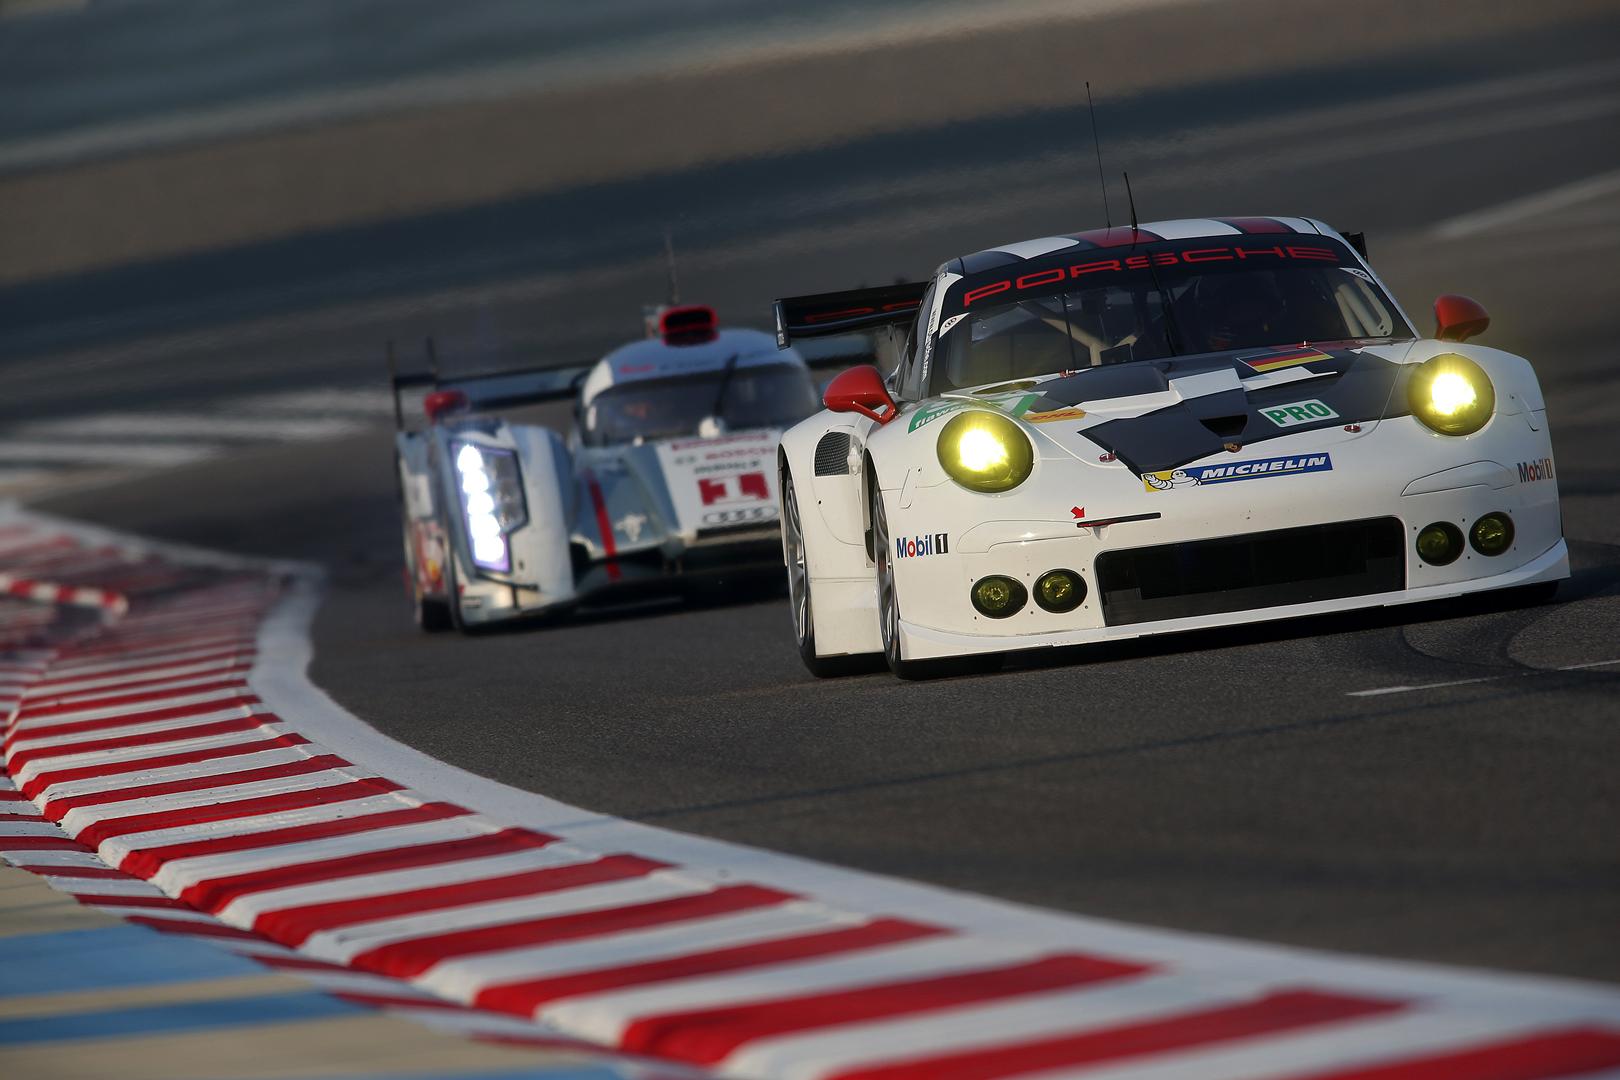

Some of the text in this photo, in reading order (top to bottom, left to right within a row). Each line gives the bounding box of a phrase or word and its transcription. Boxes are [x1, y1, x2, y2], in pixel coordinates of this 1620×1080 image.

[964, 247, 1340, 307] PORSCHE
[1265, 403, 1331, 425] PRO
[1201, 456, 1327, 479] MICHELIN
[1516, 459, 1546, 483] Mobil
[896, 533, 948, 558] Mobil 1
